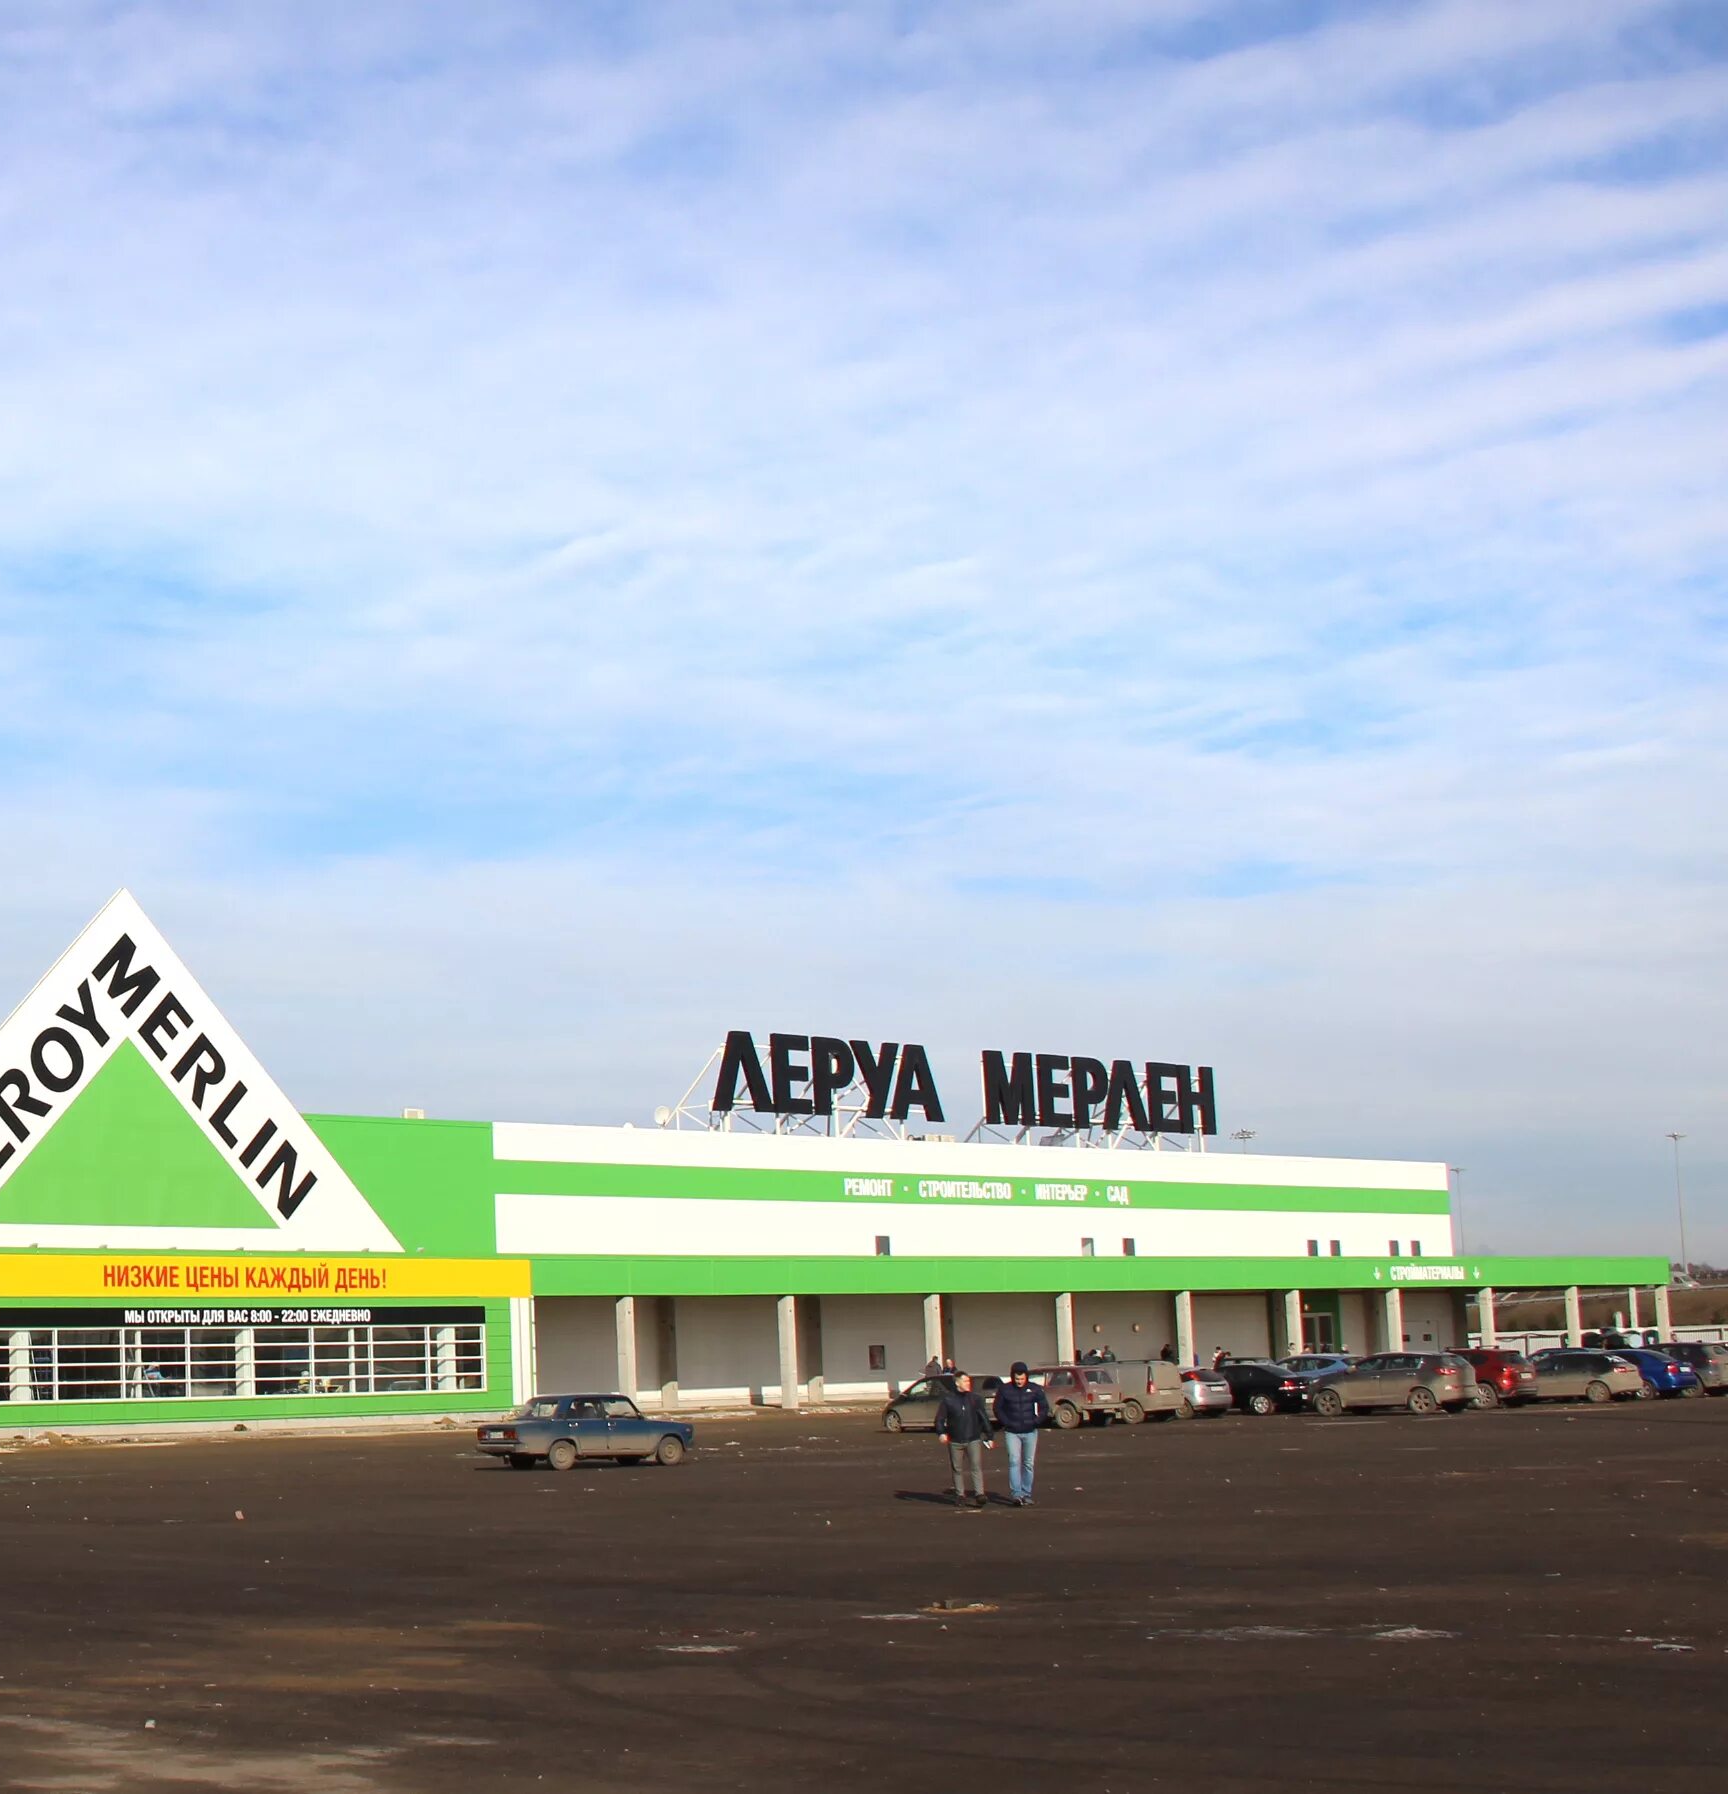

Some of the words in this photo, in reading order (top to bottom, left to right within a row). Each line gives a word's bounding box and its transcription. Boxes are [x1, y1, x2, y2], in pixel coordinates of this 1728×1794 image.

[91, 932, 318, 1221] MERLIN
[712, 1030, 945, 1122] ЛЕРУА
[980, 1049, 1217, 1135] МЕРЛЕН
[843, 1177, 893, 1197] РЕМОНТ
[918, 1180, 1012, 1200] СТРОИТЕЛЬСТВО
[1034, 1183, 1089, 1201] ИНТЕРЬЕР
[1106, 1185, 1130, 1205] САД
[103, 1264, 180, 1288] НИЗКИЕ
[185, 1266, 239, 1292] ЦЕНЫ
[245, 1262, 329, 1293] КАЖДЫЙ
[334, 1267, 387, 1293] ДЕНЬ!
[1389, 1262, 1465, 1281] СТРОЙМАТЕРИАЛЫ
[124, 1309, 145, 1324] МЫ
[147, 1309, 200, 1324] ОТКРЫТЫ
[201, 1309, 224, 1325] ДЛЯ
[226, 1309, 249, 1323] ВАС
[250, 1310, 272, 1323] 8:00
[281, 1309, 309, 1323] 22:00
[310, 1309, 371, 1325] ЕЖЕДНЕВНО
